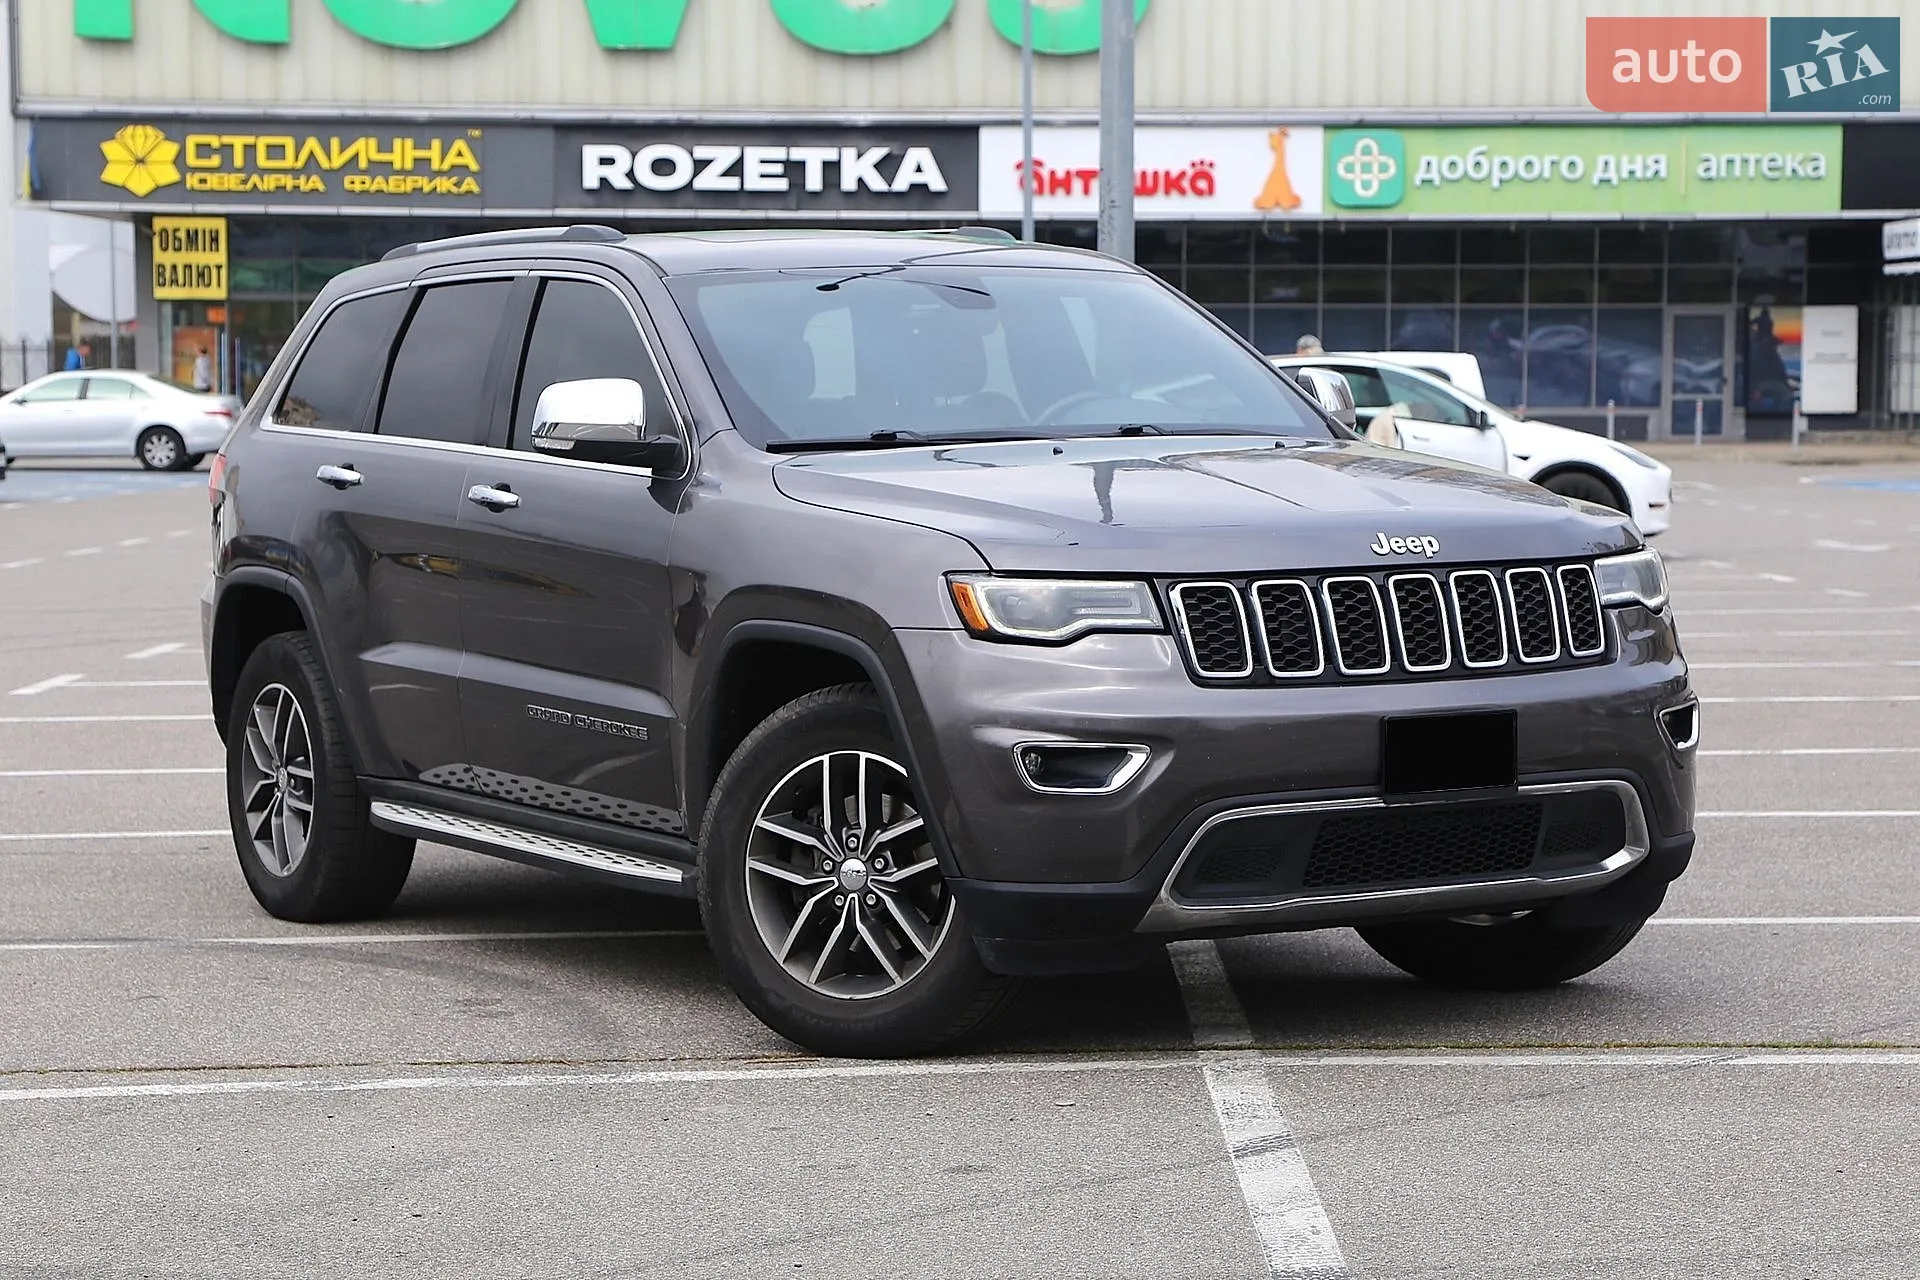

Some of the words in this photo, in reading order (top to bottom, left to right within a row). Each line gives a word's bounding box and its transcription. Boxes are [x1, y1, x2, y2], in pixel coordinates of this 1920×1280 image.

[185, 134, 481, 172] СТОЛИЧНА
[581, 143, 949, 193] ROZETKA
[1414, 145, 1585, 190] доброго
[1592, 153, 1668, 187] дня
[1697, 151, 1826, 180] аптека
[185, 172, 327, 193] ЮВЕЛІРНА
[343, 175, 482, 195] ФАБРИКА
[1015, 158, 1215, 196] антшка
[160, 228, 219, 252] ОБМІН
[156, 264, 223, 288] ВАЛЮТ
[1370, 532, 1440, 559] Jeep
[526, 704, 572, 726] GRAND
[573, 714, 649, 741] CHEROKEE
